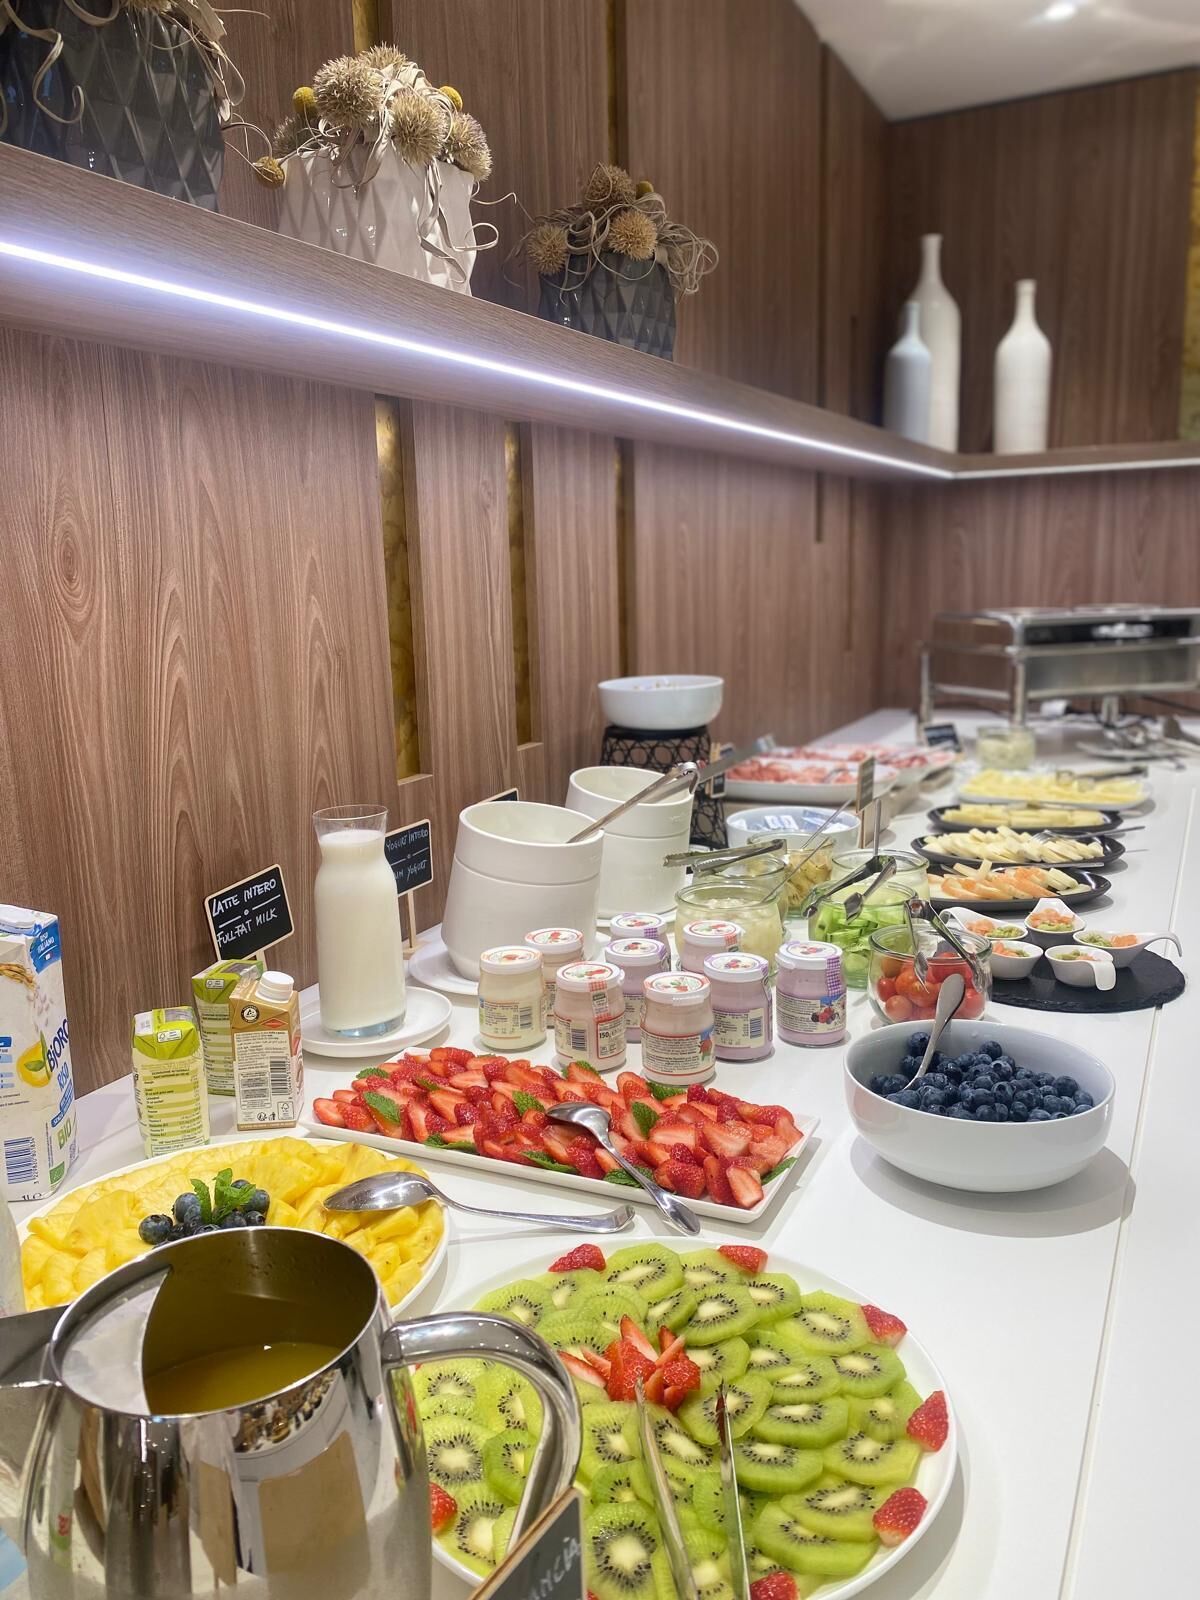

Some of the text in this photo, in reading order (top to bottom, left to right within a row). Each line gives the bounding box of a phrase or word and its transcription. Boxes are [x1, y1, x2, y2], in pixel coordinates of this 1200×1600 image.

[212, 878, 277, 917] LATTE INTERO
[255, 907, 278, 926] MILK
[57, 1116, 72, 1150] BIO
